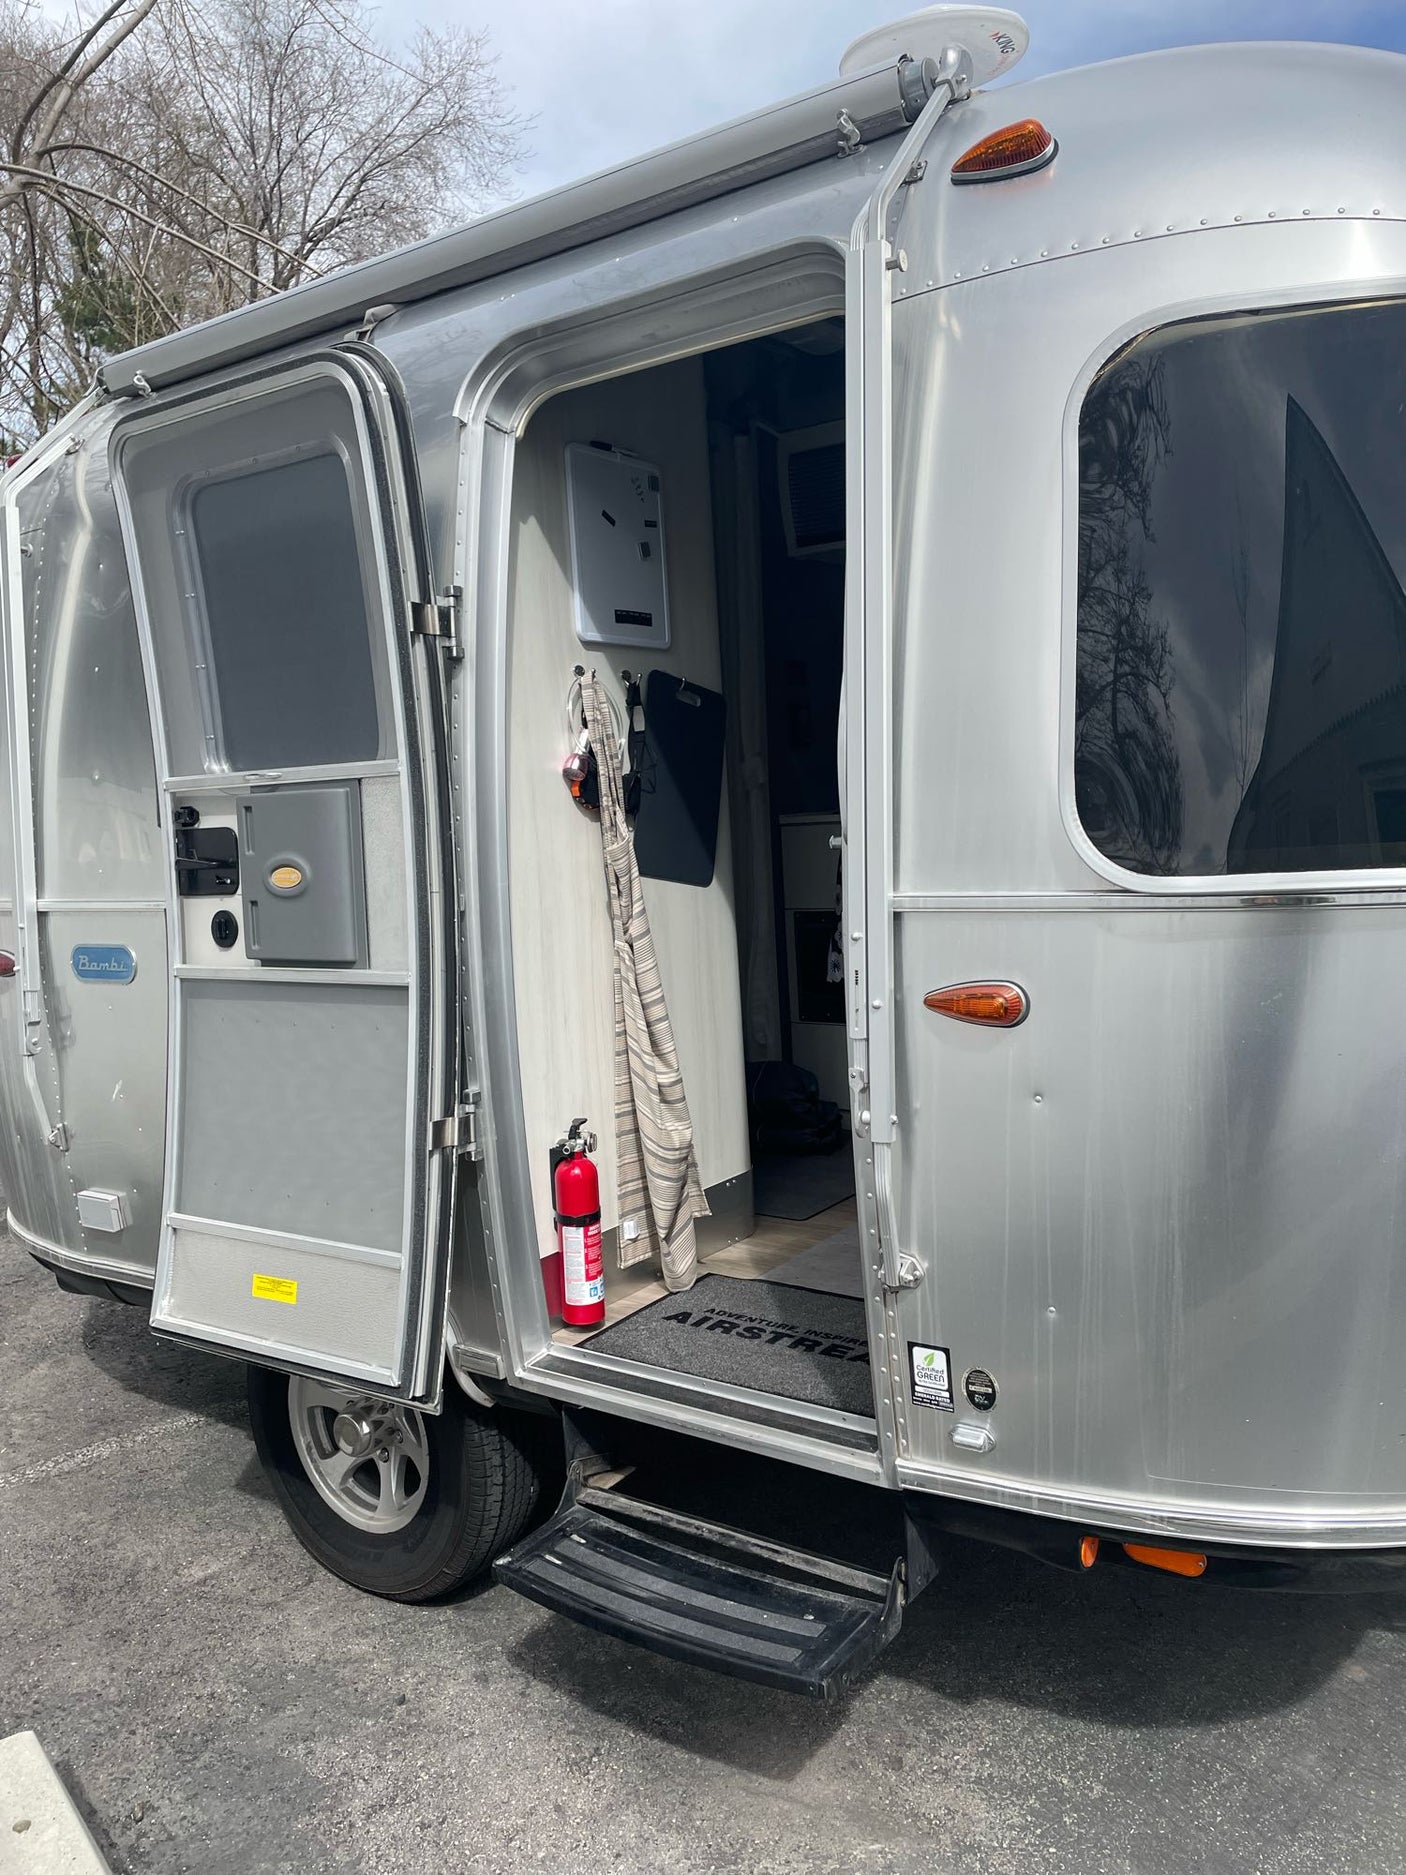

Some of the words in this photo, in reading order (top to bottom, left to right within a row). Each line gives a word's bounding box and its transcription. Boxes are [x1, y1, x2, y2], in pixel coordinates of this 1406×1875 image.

[996, 33, 1016, 54] KING
[78, 955, 128, 971] Bambi
[916, 1364, 945, 1374] Certified
[916, 1371, 945, 1383] GREEN
